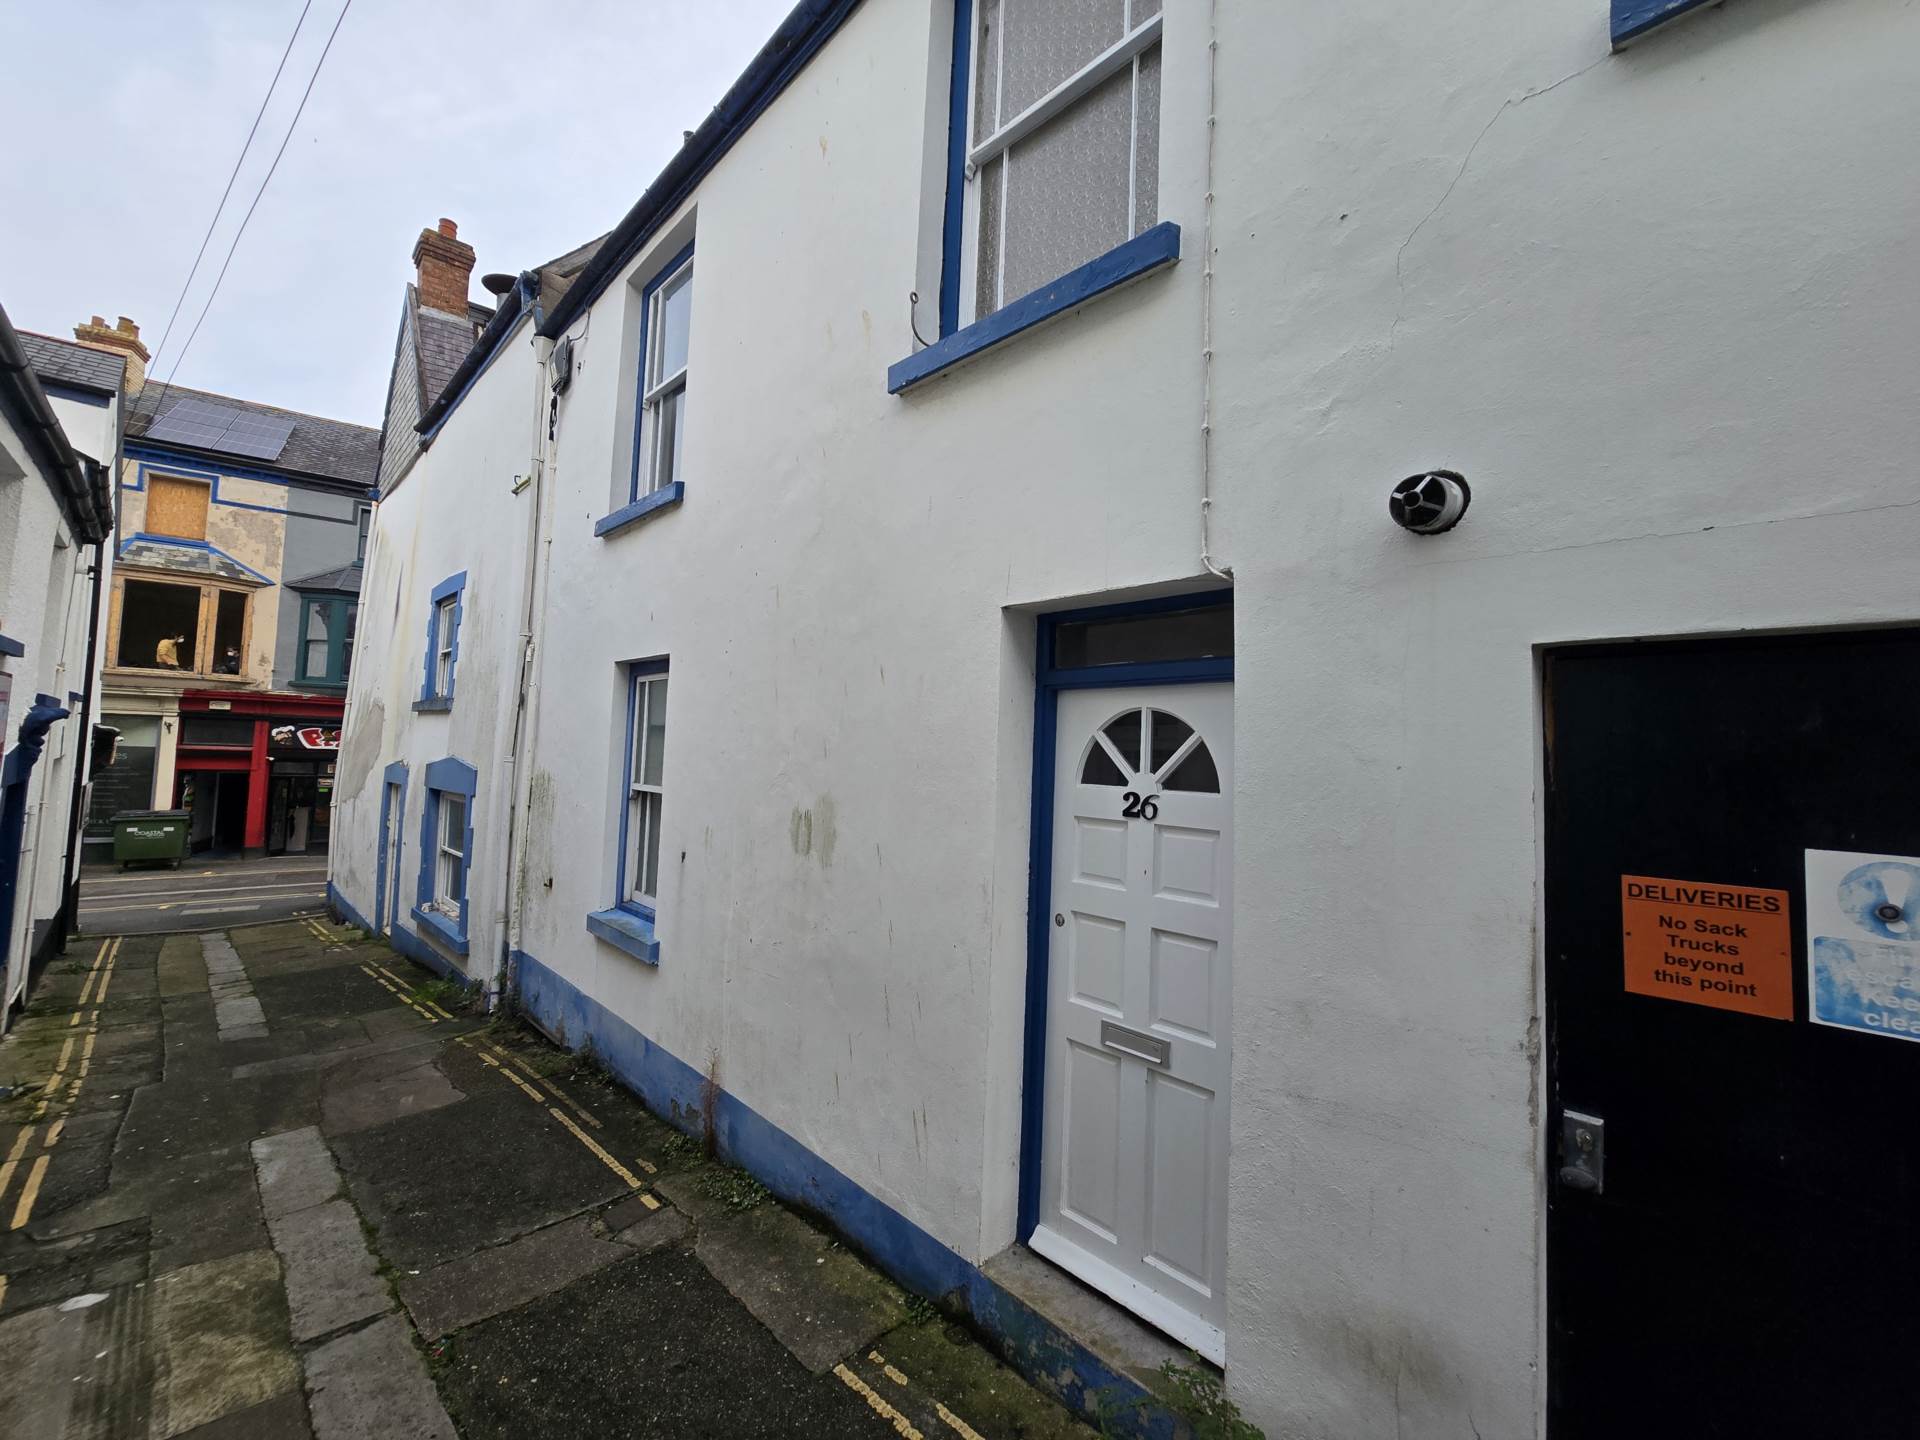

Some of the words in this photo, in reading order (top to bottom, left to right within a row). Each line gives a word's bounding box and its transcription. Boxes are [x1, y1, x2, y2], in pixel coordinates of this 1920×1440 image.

[1122, 791, 1160, 821] 26
[1627, 883, 1781, 912] DELIVERIES
[1658, 915, 1687, 931] No
[1694, 919, 1748, 938] Sack
[1667, 934, 1740, 956] Trucks
[1664, 952, 1745, 976] beyond
[1654, 970, 1693, 986] this
[1700, 978, 1757, 997] point
